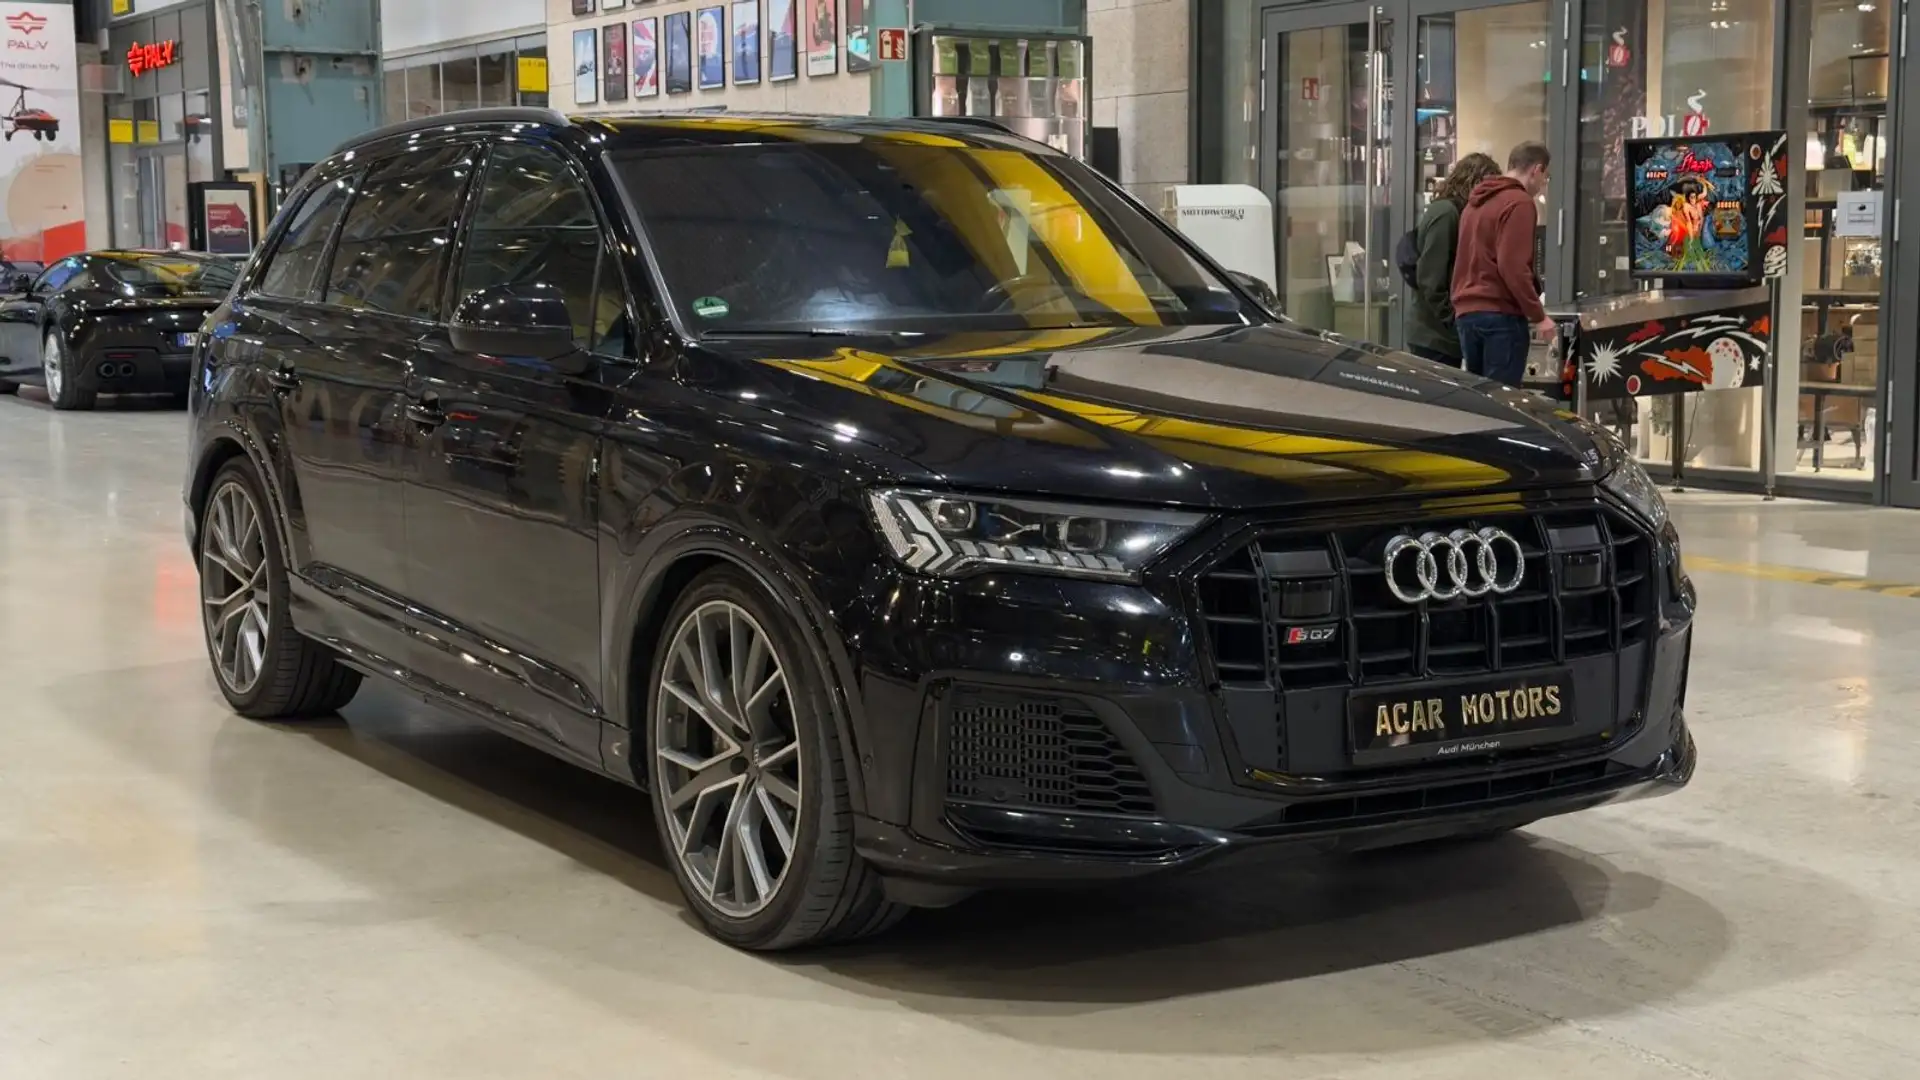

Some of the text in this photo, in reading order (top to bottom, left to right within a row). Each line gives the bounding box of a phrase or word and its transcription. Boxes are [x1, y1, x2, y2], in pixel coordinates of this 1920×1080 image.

[1376, 685, 1561, 736] ACAR MOTORS
[1438, 740, 1501, 755] Audi München
